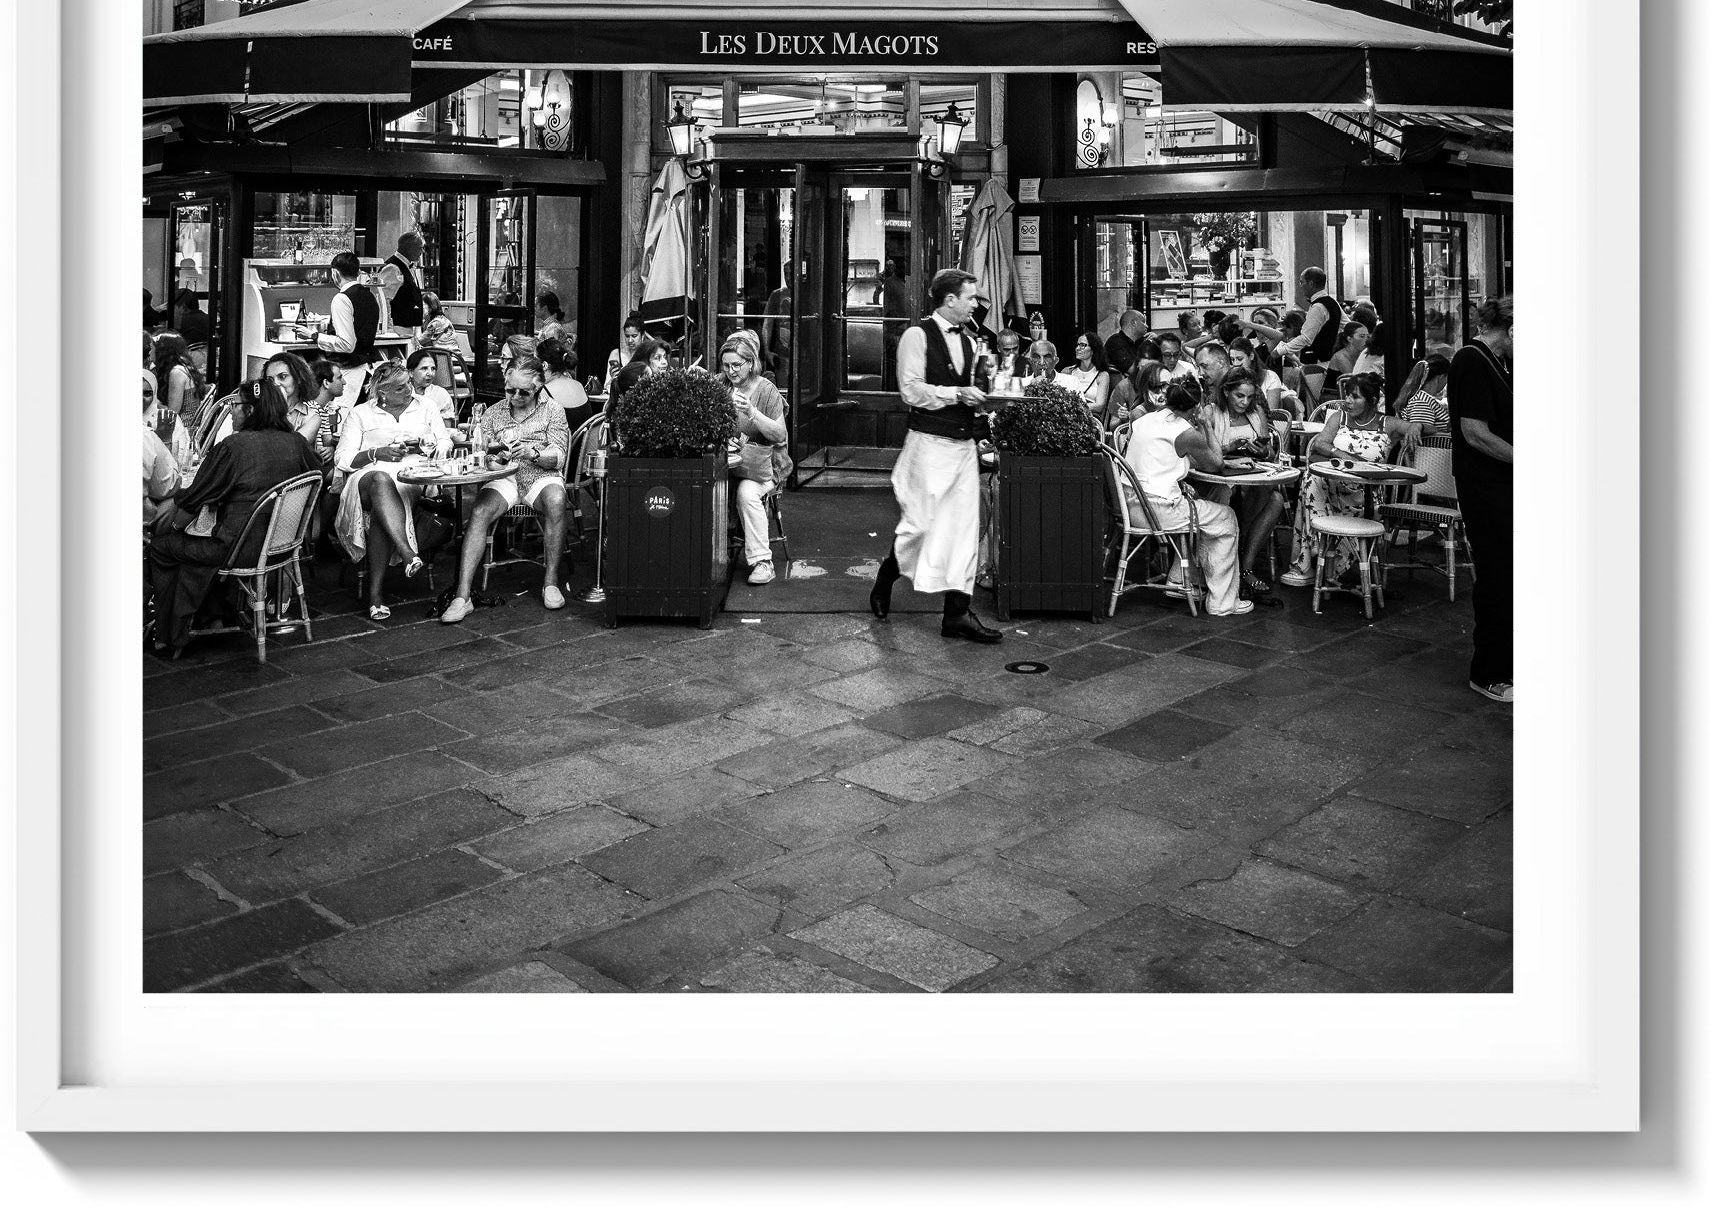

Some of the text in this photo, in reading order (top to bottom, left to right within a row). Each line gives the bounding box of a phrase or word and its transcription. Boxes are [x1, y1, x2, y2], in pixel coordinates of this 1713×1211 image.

[412, 35, 453, 50] CAFÉ
[699, 31, 939, 55] LES DEUX MAGOTS
[1126, 42, 1157, 54] RES
